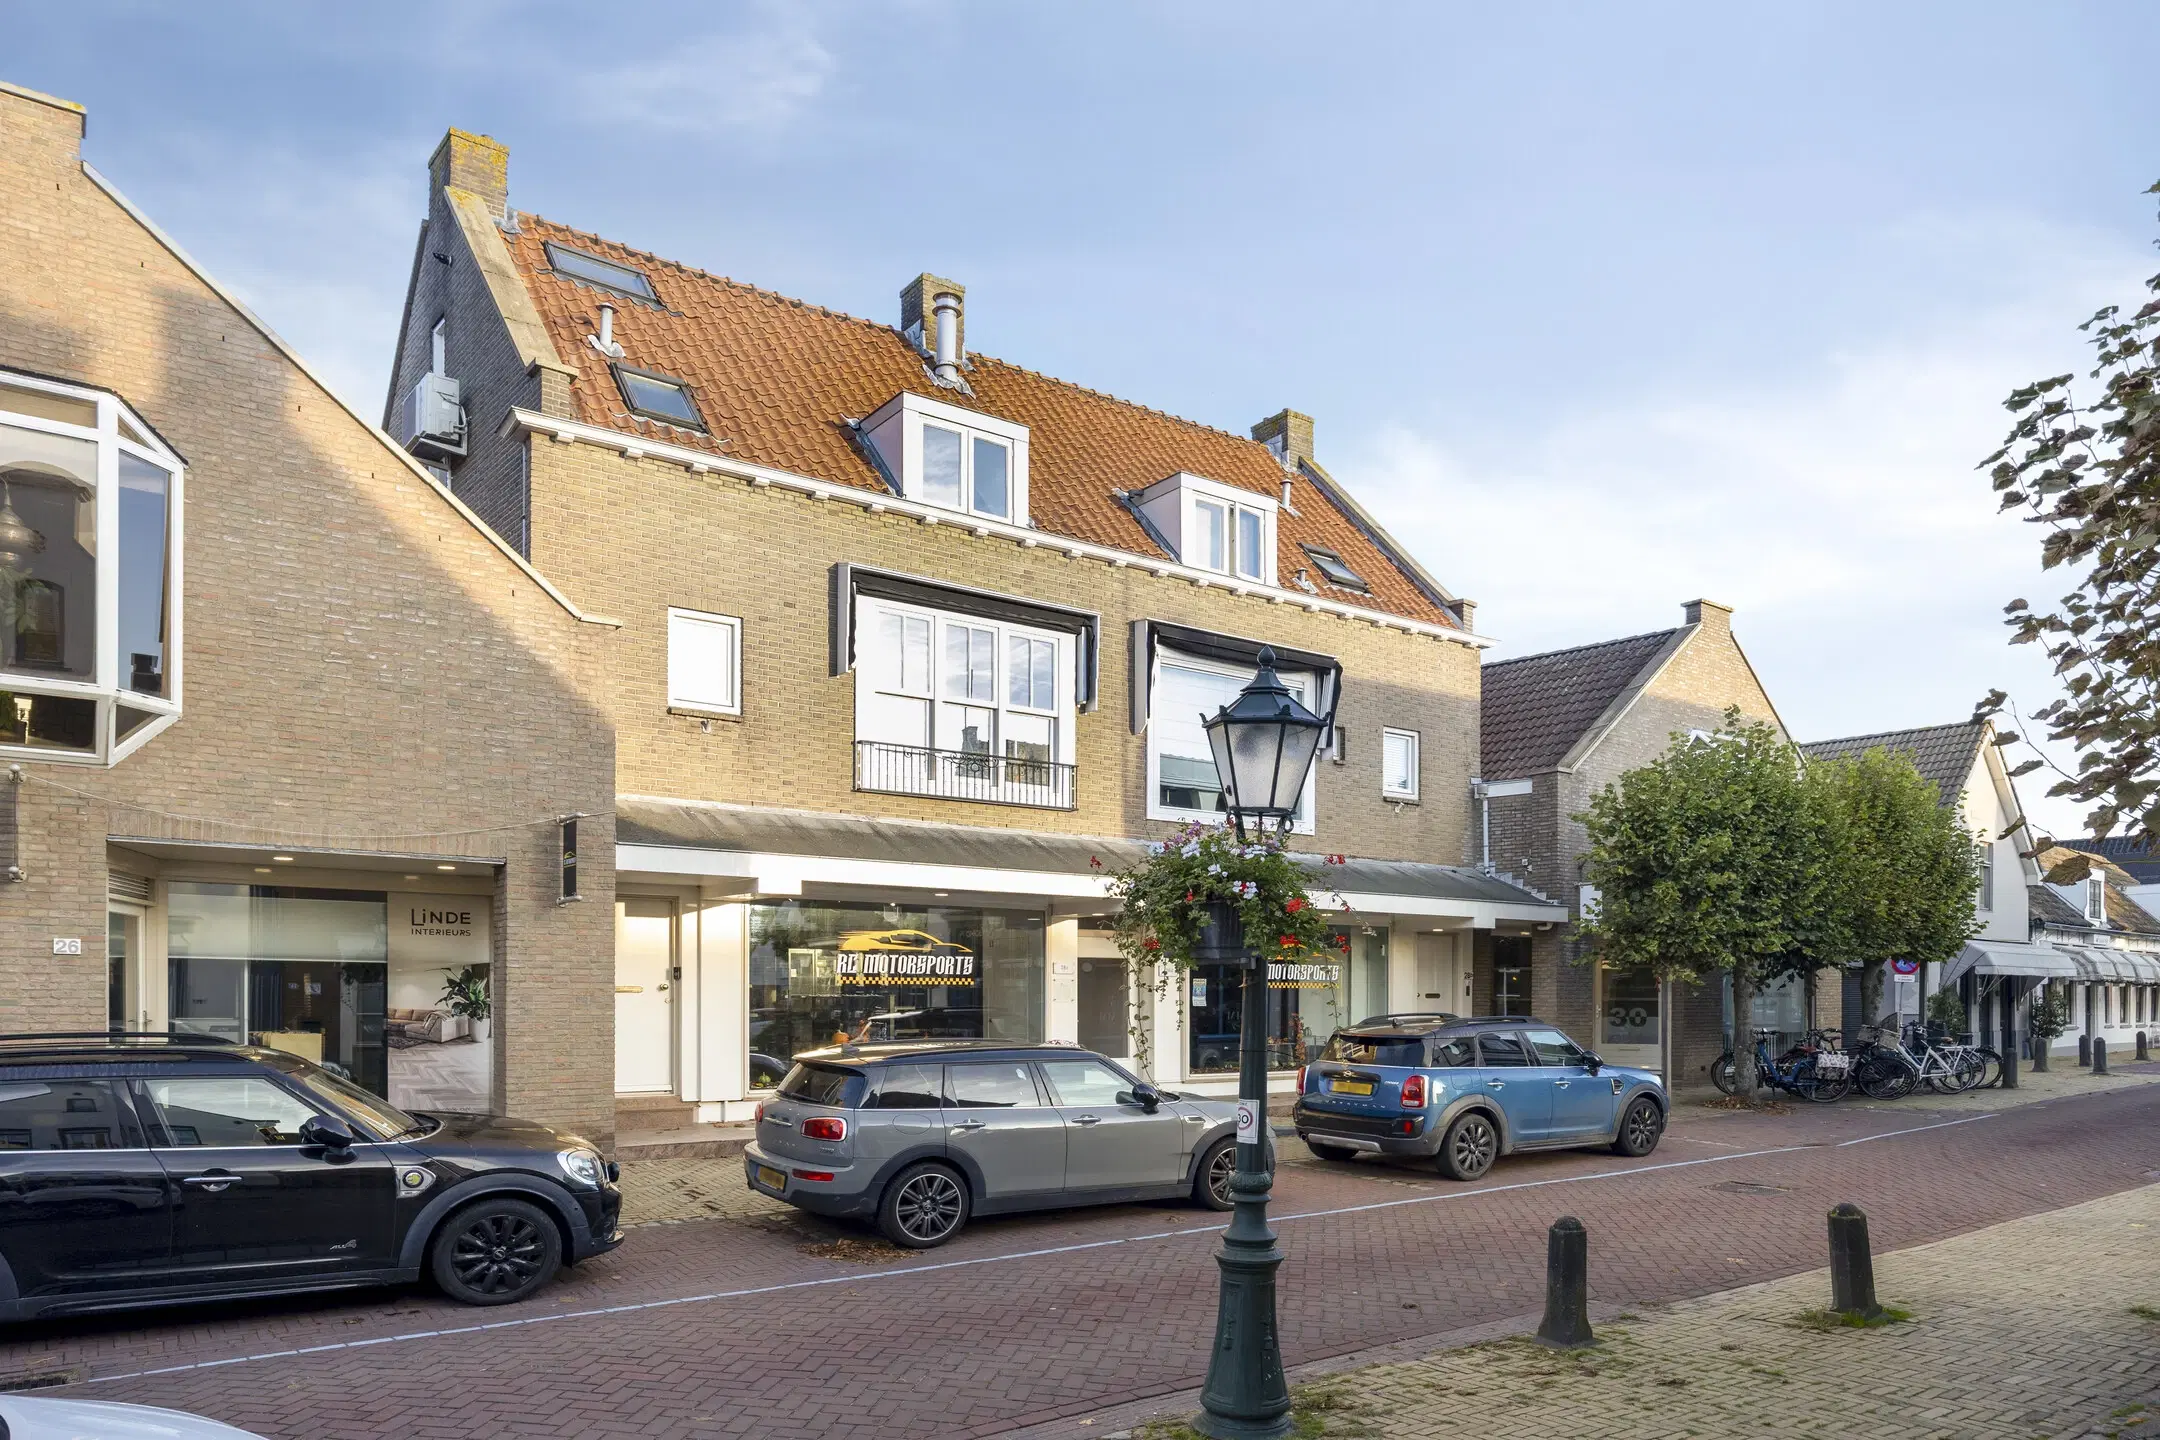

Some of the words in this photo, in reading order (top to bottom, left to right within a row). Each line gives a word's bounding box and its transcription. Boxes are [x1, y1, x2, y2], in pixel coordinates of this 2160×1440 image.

[411, 928, 472, 937] INTERIEURS
[55, 940, 79, 953] 26
[836, 953, 857, 974] RC
[863, 954, 974, 975] MOTORSPORTS
[1609, 1007, 1648, 1028] 30
